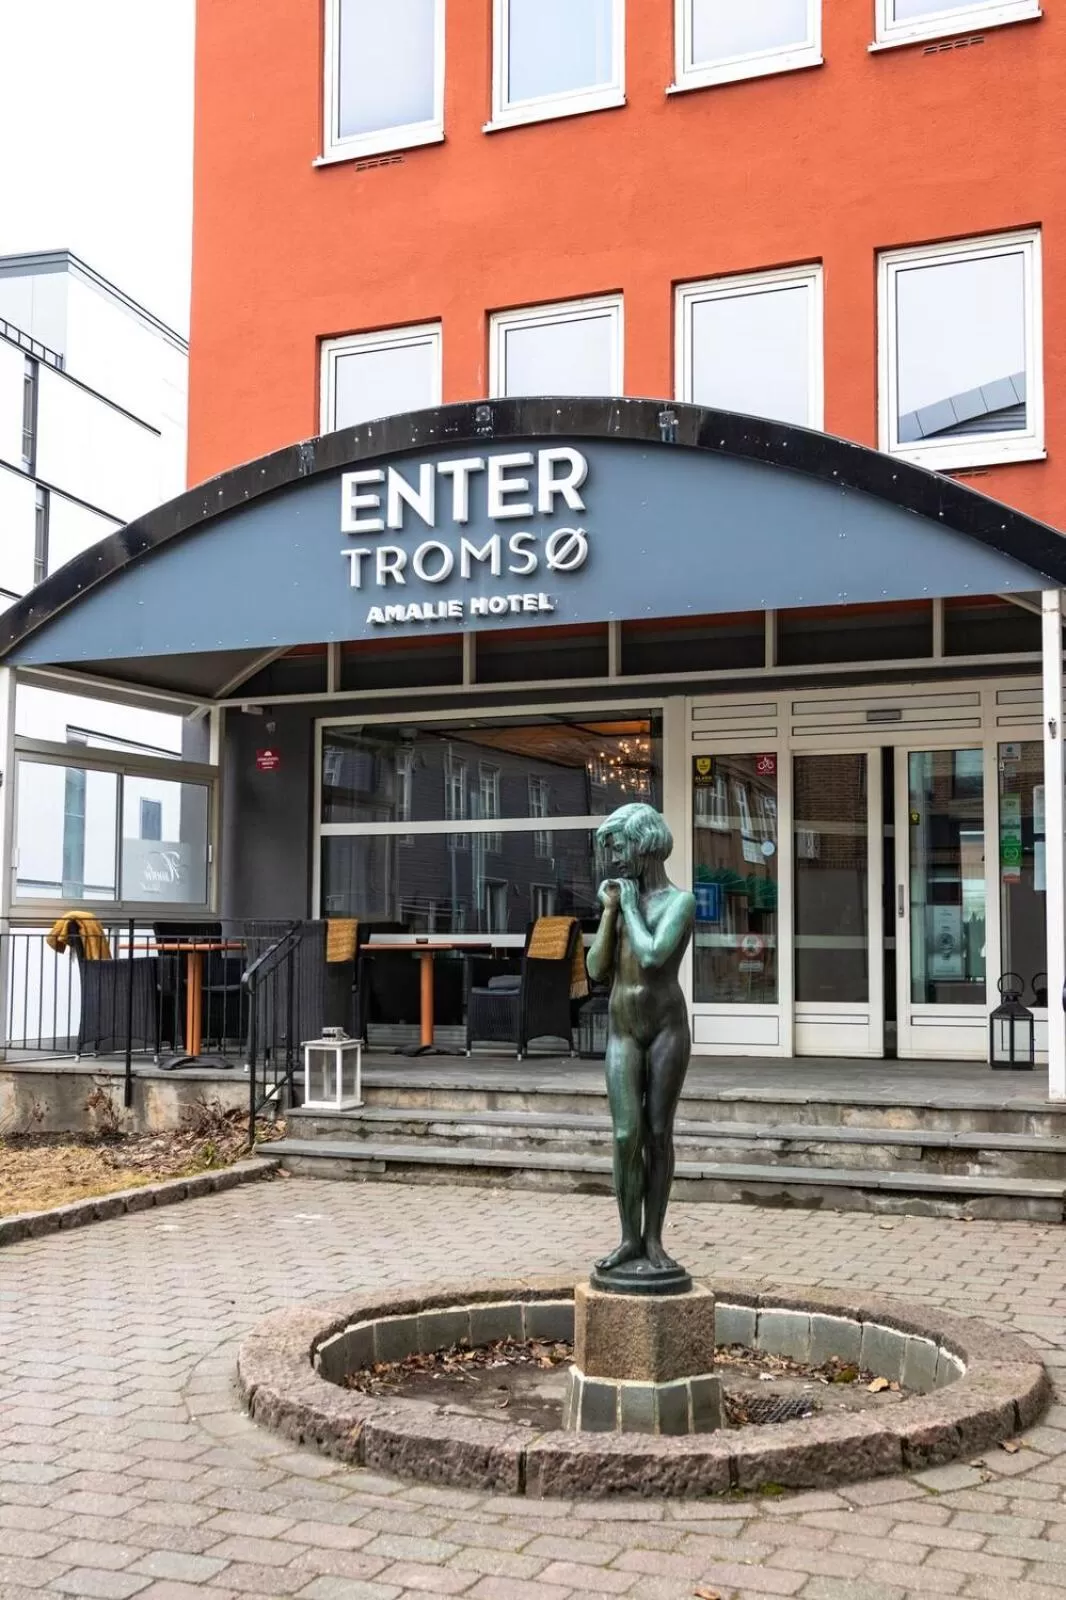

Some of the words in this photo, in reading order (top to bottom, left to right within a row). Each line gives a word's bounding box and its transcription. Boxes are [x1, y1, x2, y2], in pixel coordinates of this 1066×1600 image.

[341, 447, 588, 535] ENTER
[341, 528, 588, 588] TROMSØ
[366, 600, 463, 624] AMALIE
[470, 593, 554, 615] HOTEL
